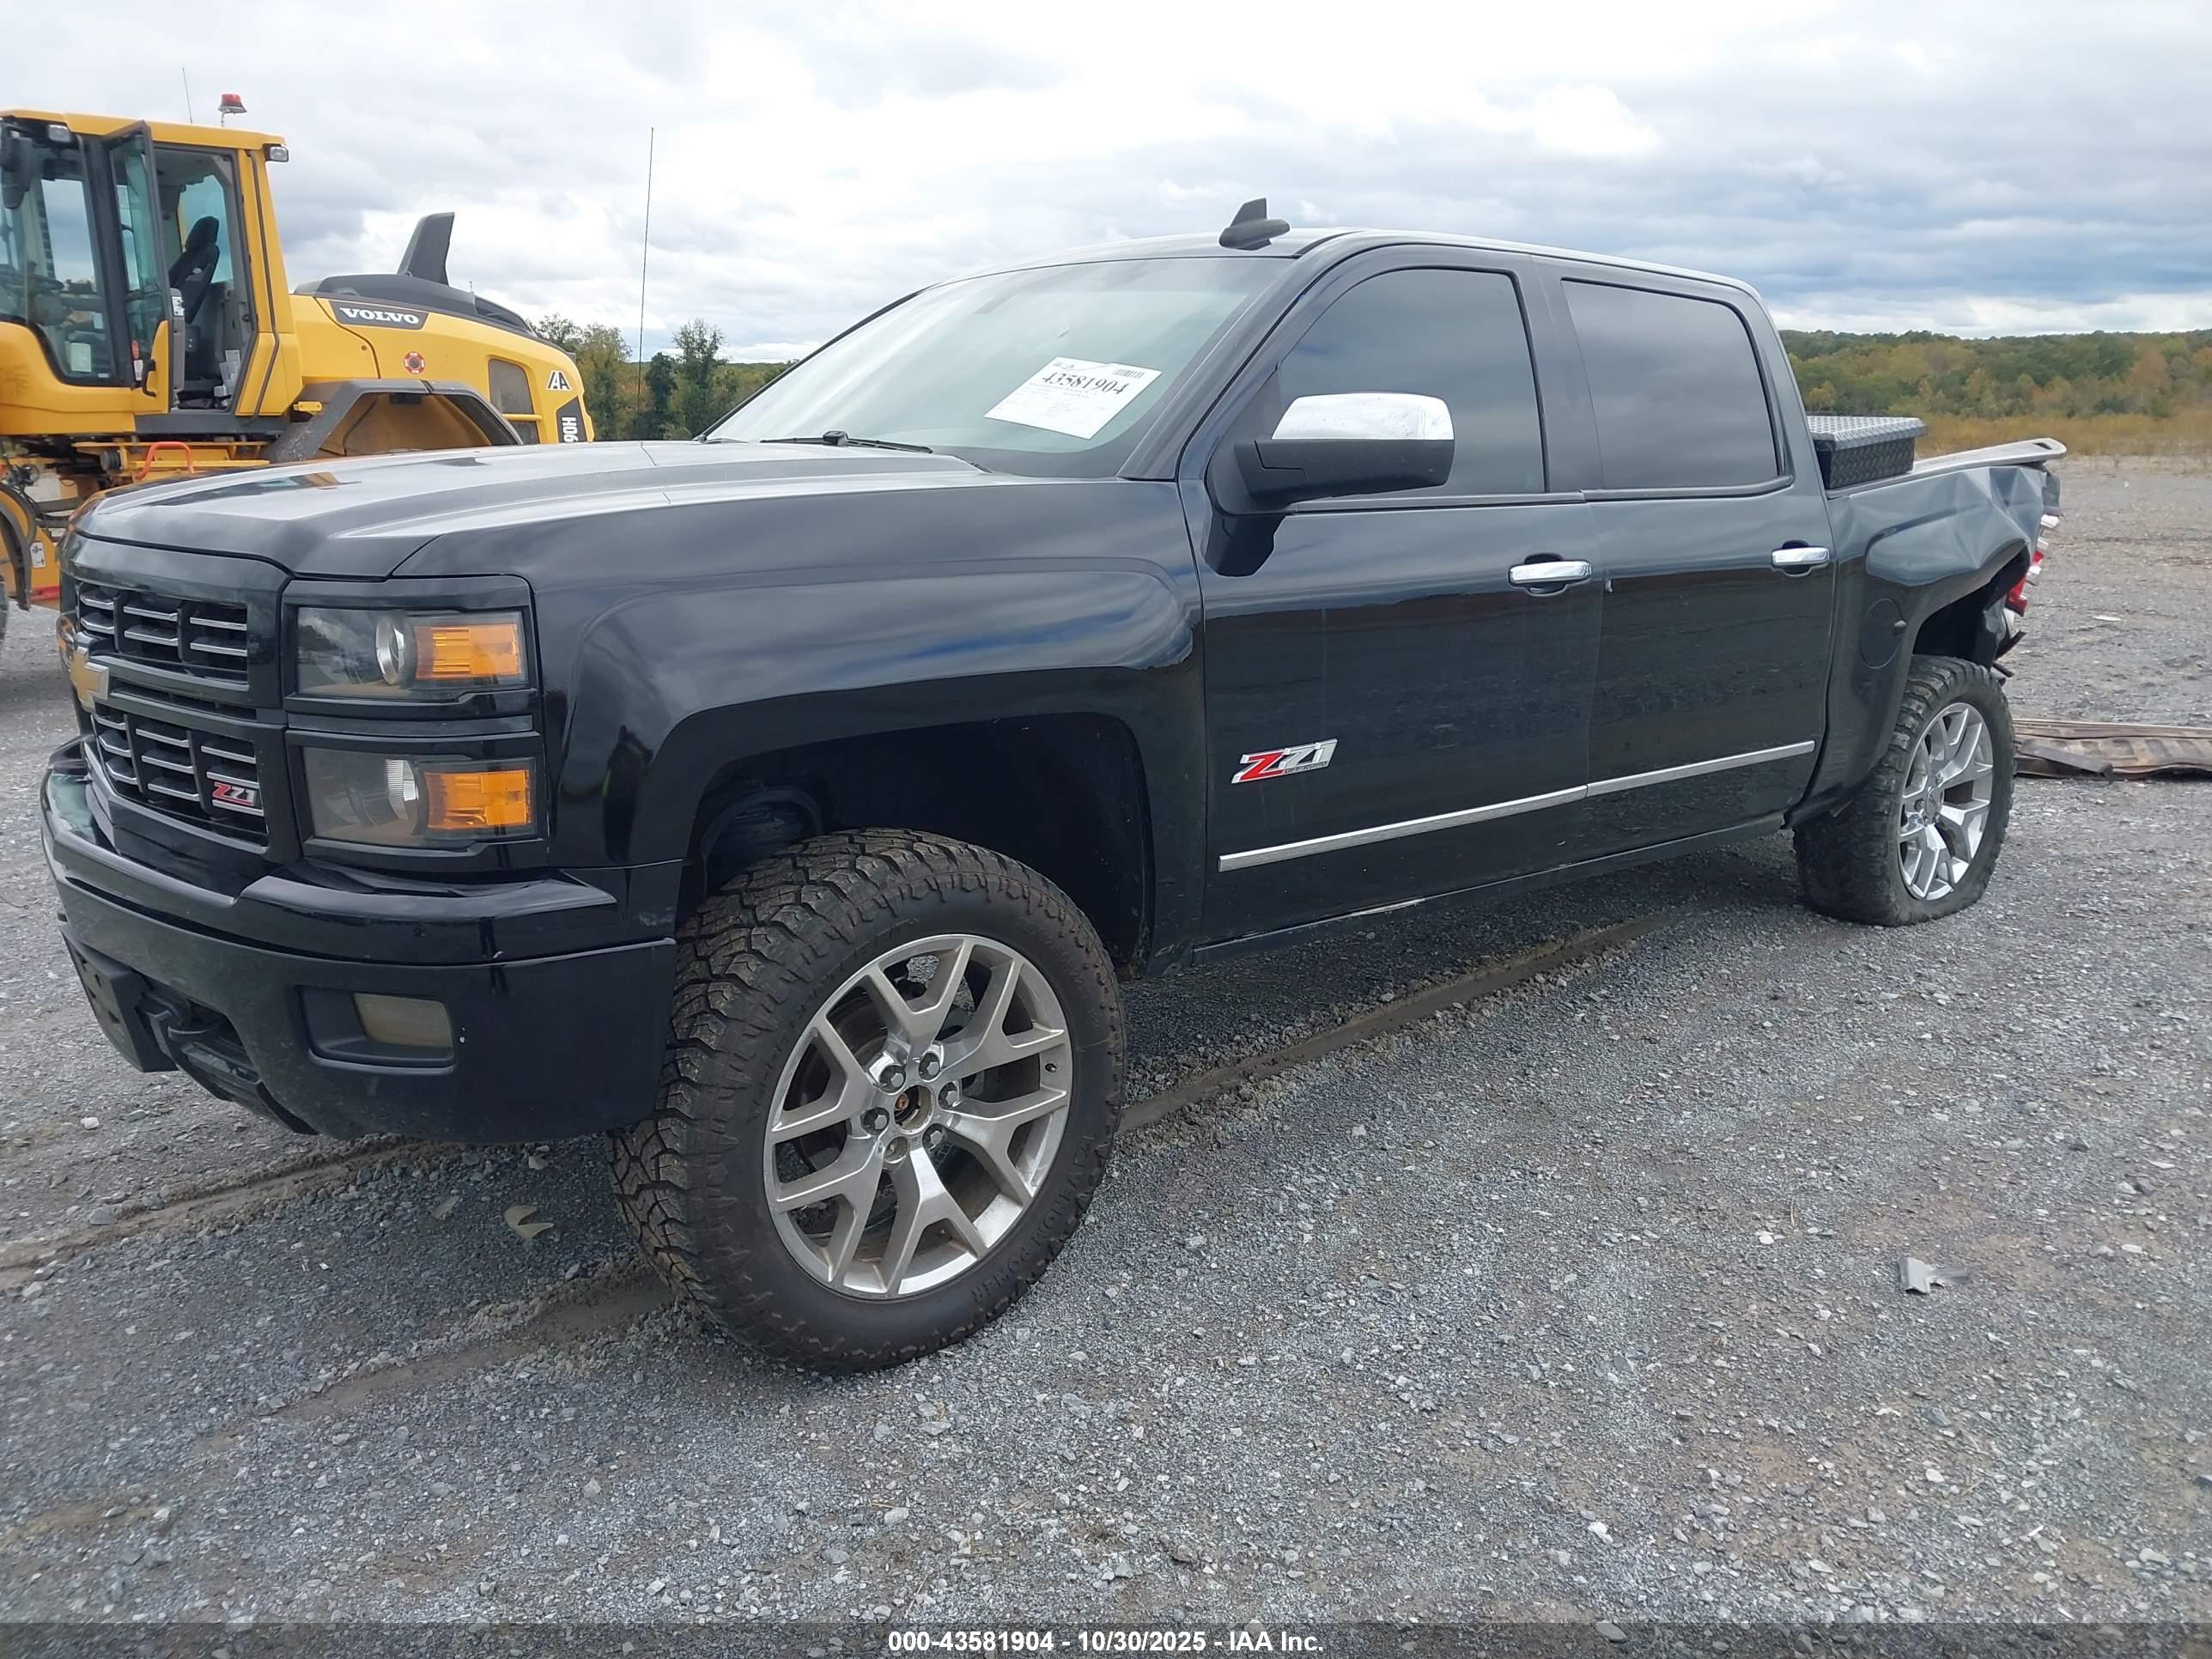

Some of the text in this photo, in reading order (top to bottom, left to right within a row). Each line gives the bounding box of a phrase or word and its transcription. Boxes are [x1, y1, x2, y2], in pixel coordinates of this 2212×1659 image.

[338, 307, 420, 325] VOLVO
[1042, 371, 1130, 395] 43581904
[1231, 738, 1339, 784] Z71
[212, 781, 257, 806] Z71
[970, 1246, 1032, 1304] POWER
